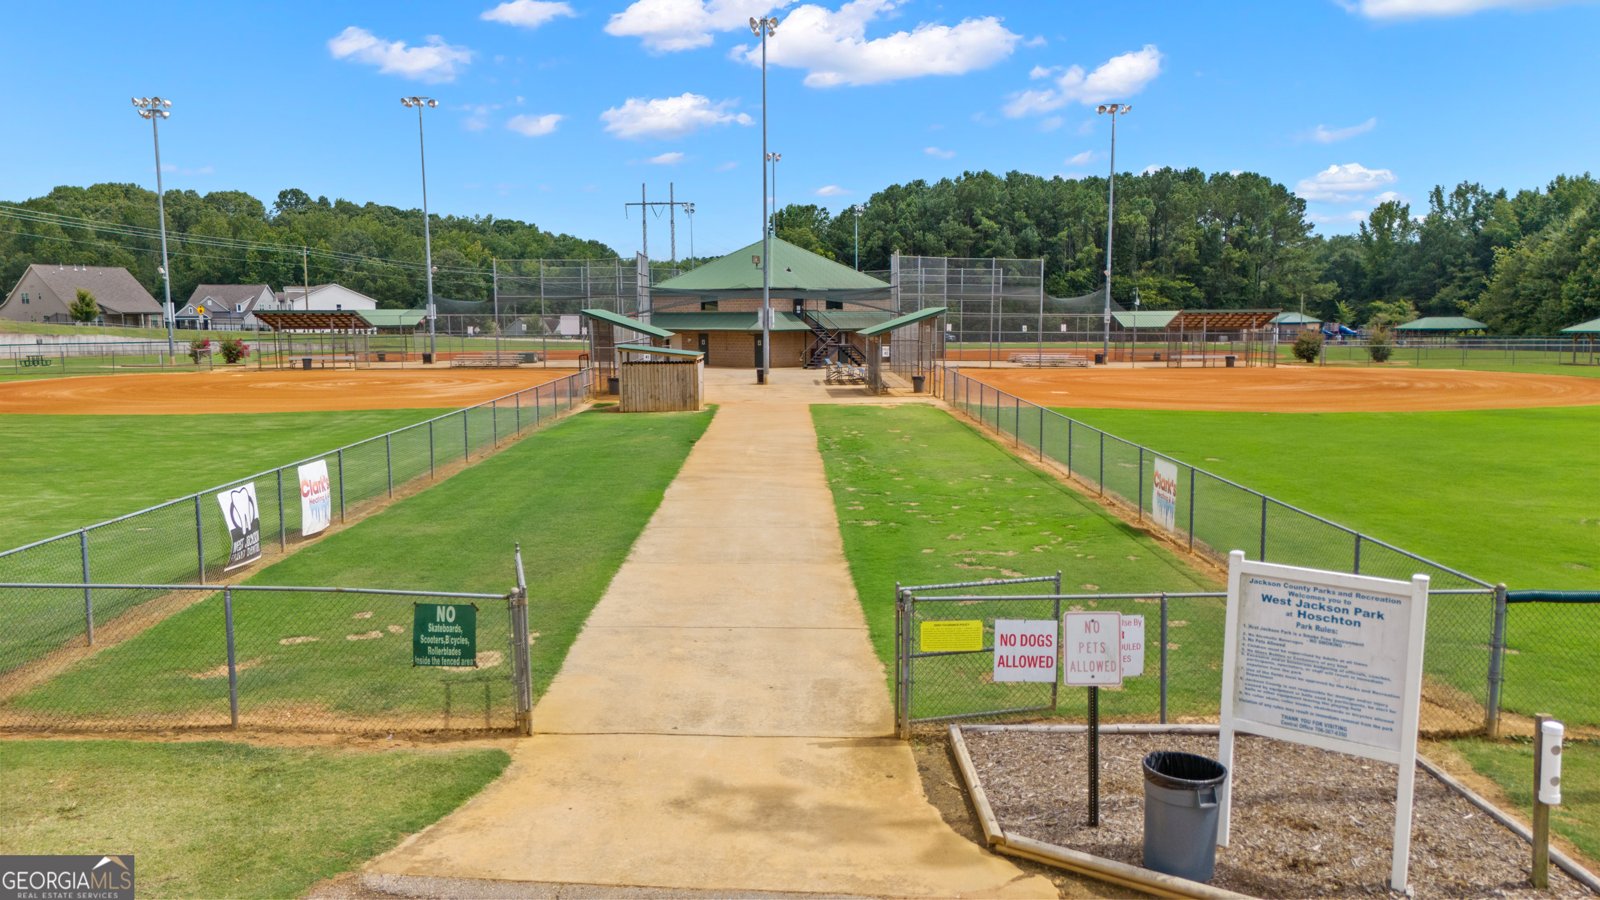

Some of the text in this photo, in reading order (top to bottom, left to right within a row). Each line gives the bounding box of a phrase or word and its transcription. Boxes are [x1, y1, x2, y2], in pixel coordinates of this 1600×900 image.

[302, 476, 329, 498] Clark's
[1249, 577, 1401, 605] Jackson County Parks and Recreation
[1287, 590, 1325, 601] Welcomes
[1261, 593, 1385, 620] West Jackson Park
[436, 606, 456, 622] NO
[1297, 609, 1361, 627] Hoschton
[428, 623, 463, 634] Skateboards,
[1085, 621, 1099, 634] NO
[1134, 618, 1142, 627] By
[1295, 621, 1338, 634] Park Rules:
[445, 635, 470, 646] Bcycles,
[1000, 634, 1052, 647] NO DOGS
[428, 646, 461, 655] Rollerblades
[1079, 642, 1106, 654] PETS
[432, 656, 440, 665] the
[441, 657, 460, 665] fenced
[461, 658, 473, 666] area
[997, 655, 1054, 668] ALLOWED
[1070, 661, 1116, 673] ALLOWED
[1281, 714, 1298, 722] THANK
[1323, 722, 1347, 731] VISITING
[1299, 723, 1313, 731] Office
